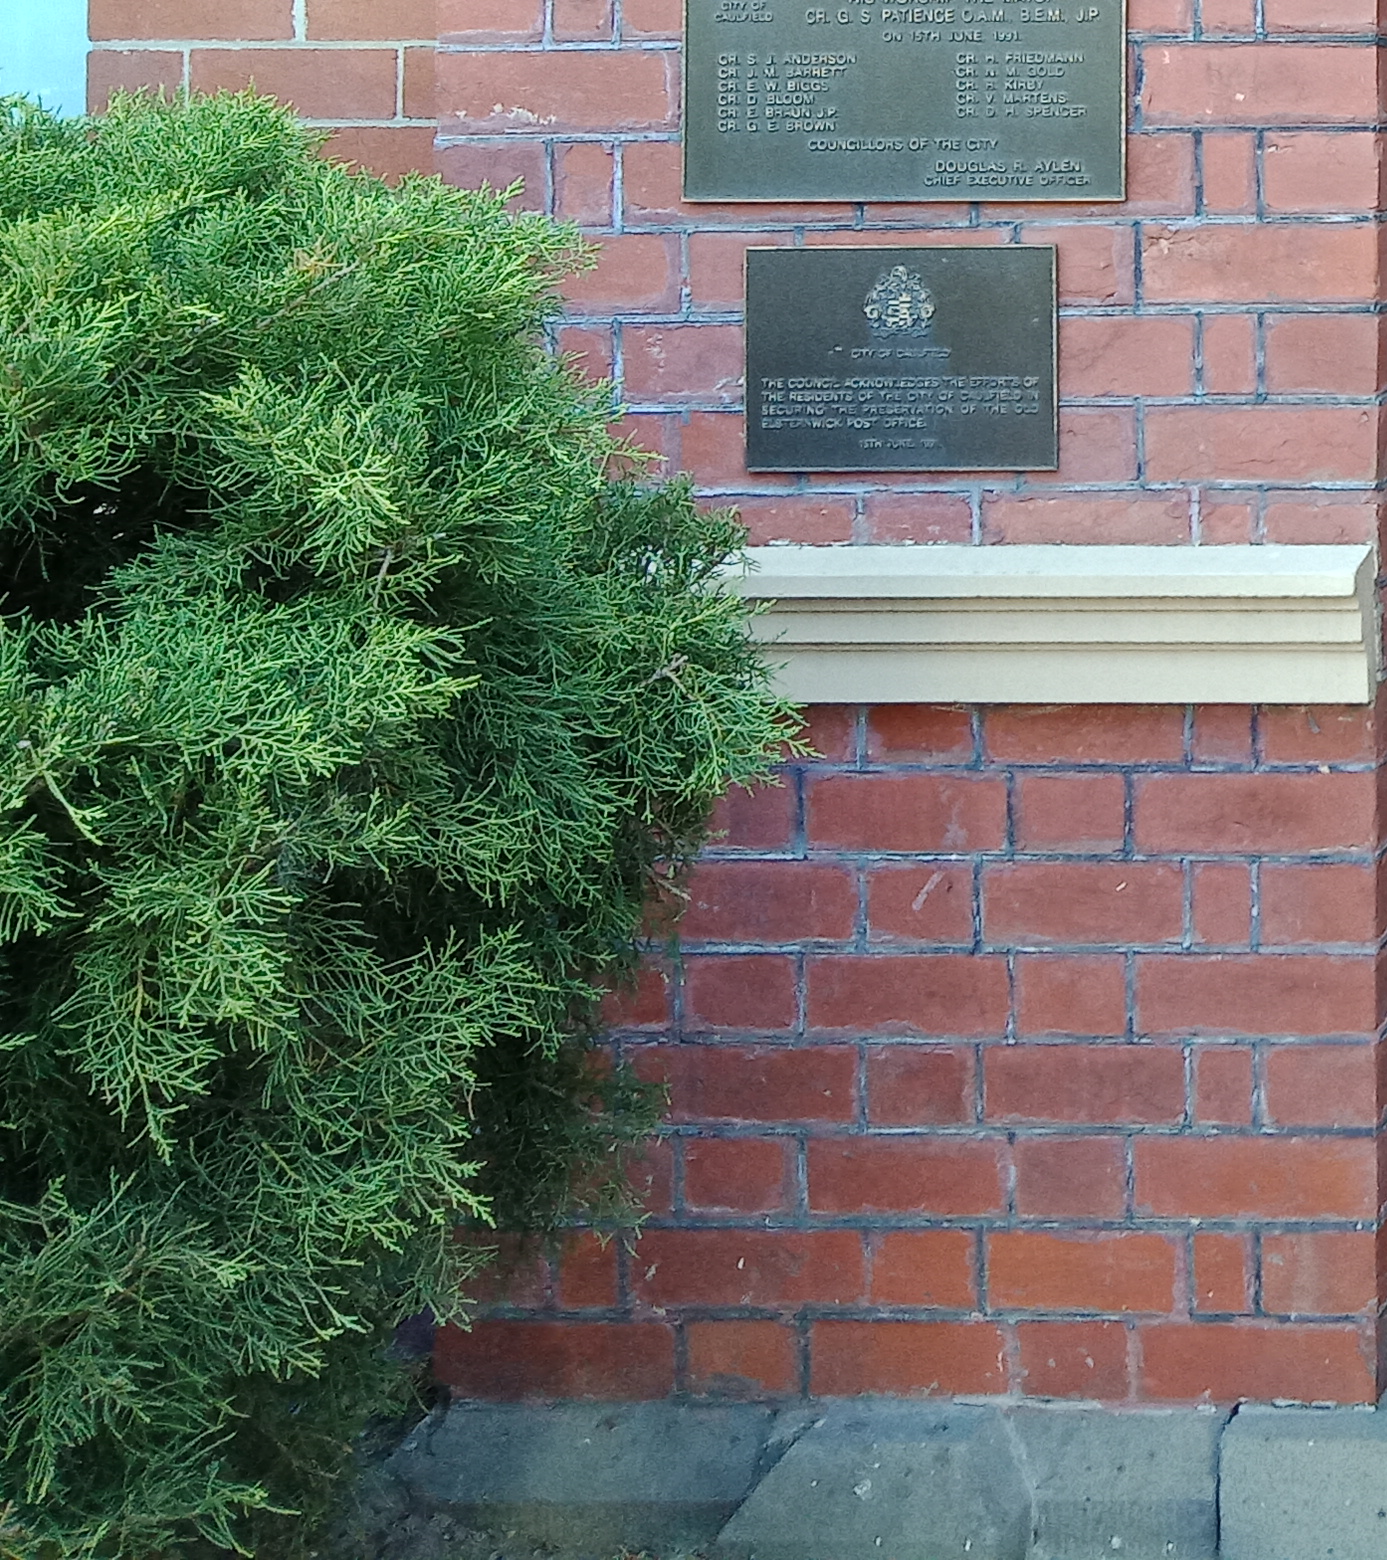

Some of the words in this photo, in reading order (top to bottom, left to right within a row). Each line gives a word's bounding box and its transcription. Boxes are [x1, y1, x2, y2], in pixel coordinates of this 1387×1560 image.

[721, 0, 747, 11] CITY
[752, 0, 767, 11] OF
[714, 12, 774, 23] CAULFIELD
[804, 7, 831, 24] CR.
[881, 7, 955, 24] PATIENCE
[882, 30, 903, 42] ON
[912, 30, 942, 42] 15TH
[782, 53, 857, 66] ANDERSON
[1005, 52, 1085, 65] FRIEDMANN
[786, 67, 847, 79] BARRETT
[1027, 66, 1066, 78] GOLD
[787, 80, 830, 93] BIGGS
[1004, 79, 1044, 91] KIRBY
[766, 94, 815, 106] BLOOM
[1003, 93, 1068, 105] MARTENS
[765, 107, 811, 119] BRAUN
[1026, 106, 1087, 118] SPENCER
[785, 121, 837, 133] BROWN
[808, 138, 904, 152] COUNCILLORS
[908, 138, 928, 152] OF
[933, 138, 960, 152] THE
[966, 138, 999, 152] CITY
[935, 160, 1007, 173] DOUGLAS
[1034, 160, 1083, 173] AYLEN
[924, 175, 961, 187] CHIEF
[966, 175, 1034, 187] EXECUTIVE
[1039, 174, 1091, 187] OFFICER
[761, 376, 785, 389] THE
[787, 376, 840, 389] COUNCIL
[844, 376, 940, 389] ACKNOWLEDGES
[969, 376, 1020, 389] EFFORTS
[1023, 376, 1040, 389] OF
[761, 390, 785, 403] THE
[789, 390, 854, 403] RESIDENTS
[858, 390, 875, 403] OF
[907, 390, 934, 403] CITY
[938, 390, 955, 403] OF
[761, 404, 825, 416] SECURING
[862, 404, 954, 416] PRESERVATION
[960, 404, 977, 416] OF
[984, 404, 1008, 416] THE
